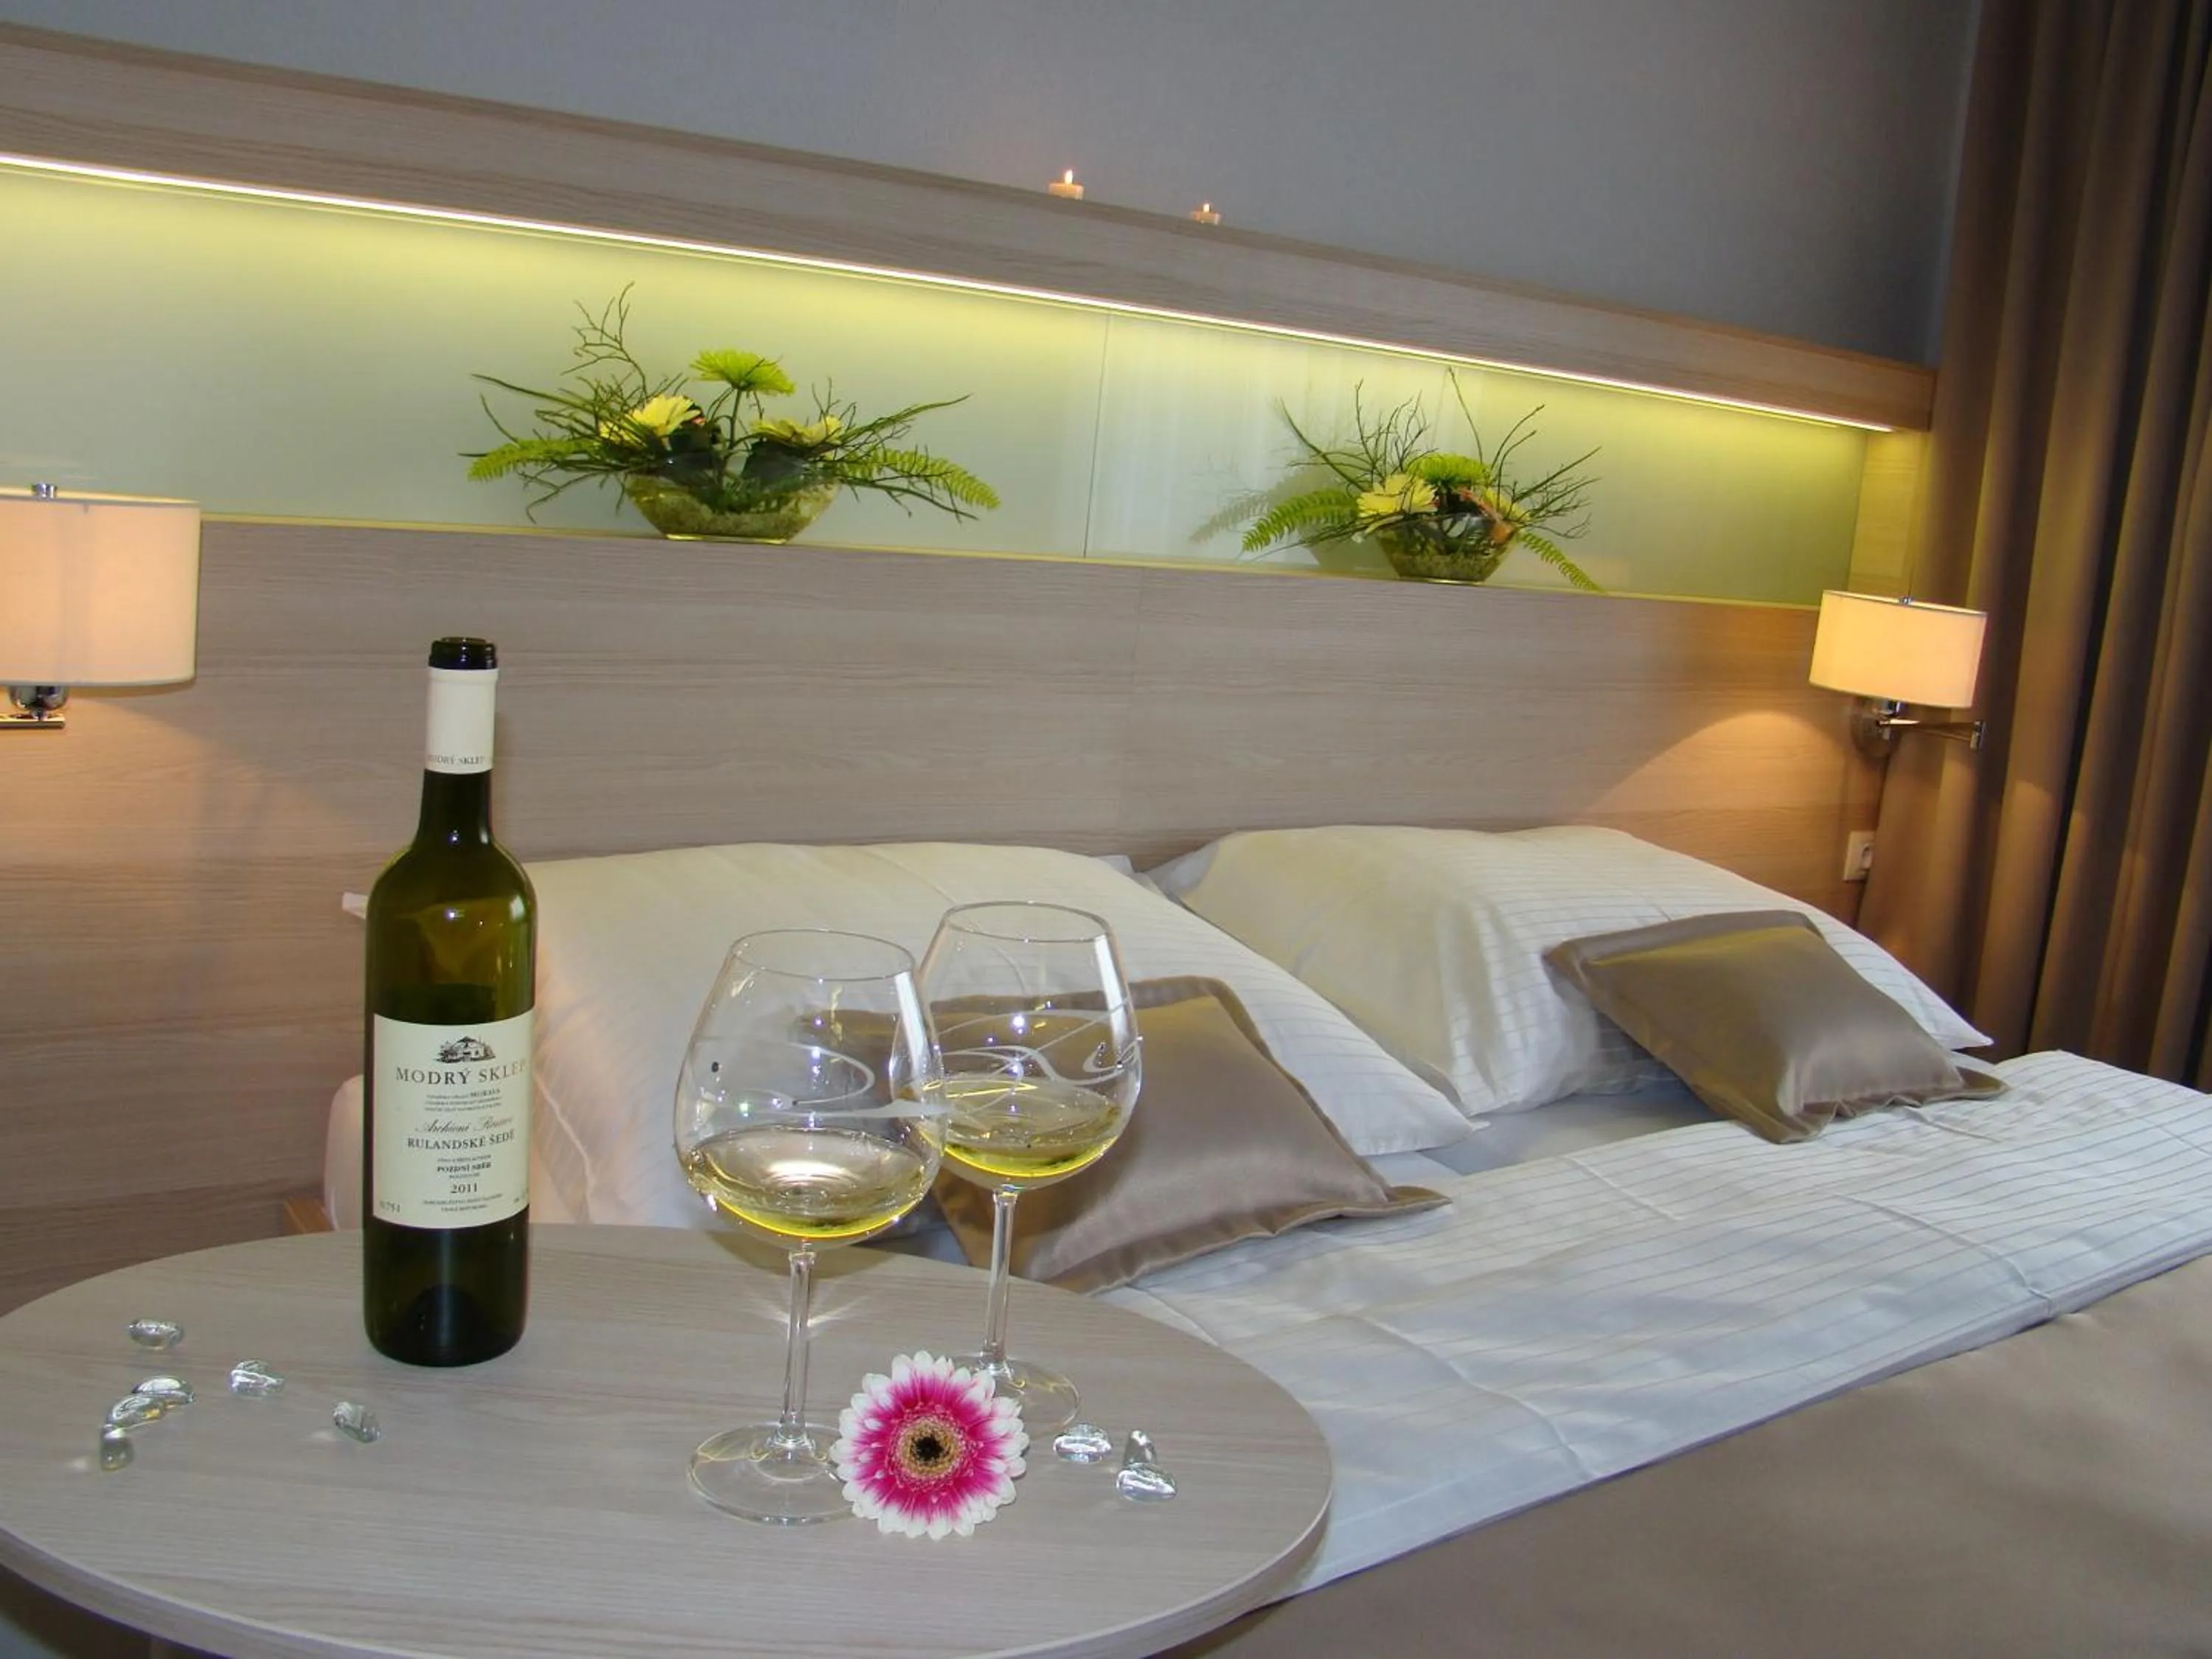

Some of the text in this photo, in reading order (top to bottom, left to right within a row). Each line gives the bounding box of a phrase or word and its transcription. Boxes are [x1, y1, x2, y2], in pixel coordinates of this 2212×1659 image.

[396, 1066, 472, 1085] MODRÝ
[407, 1135, 486, 1150] RULANDSKÉ
[451, 1181, 478, 1194] 2011
